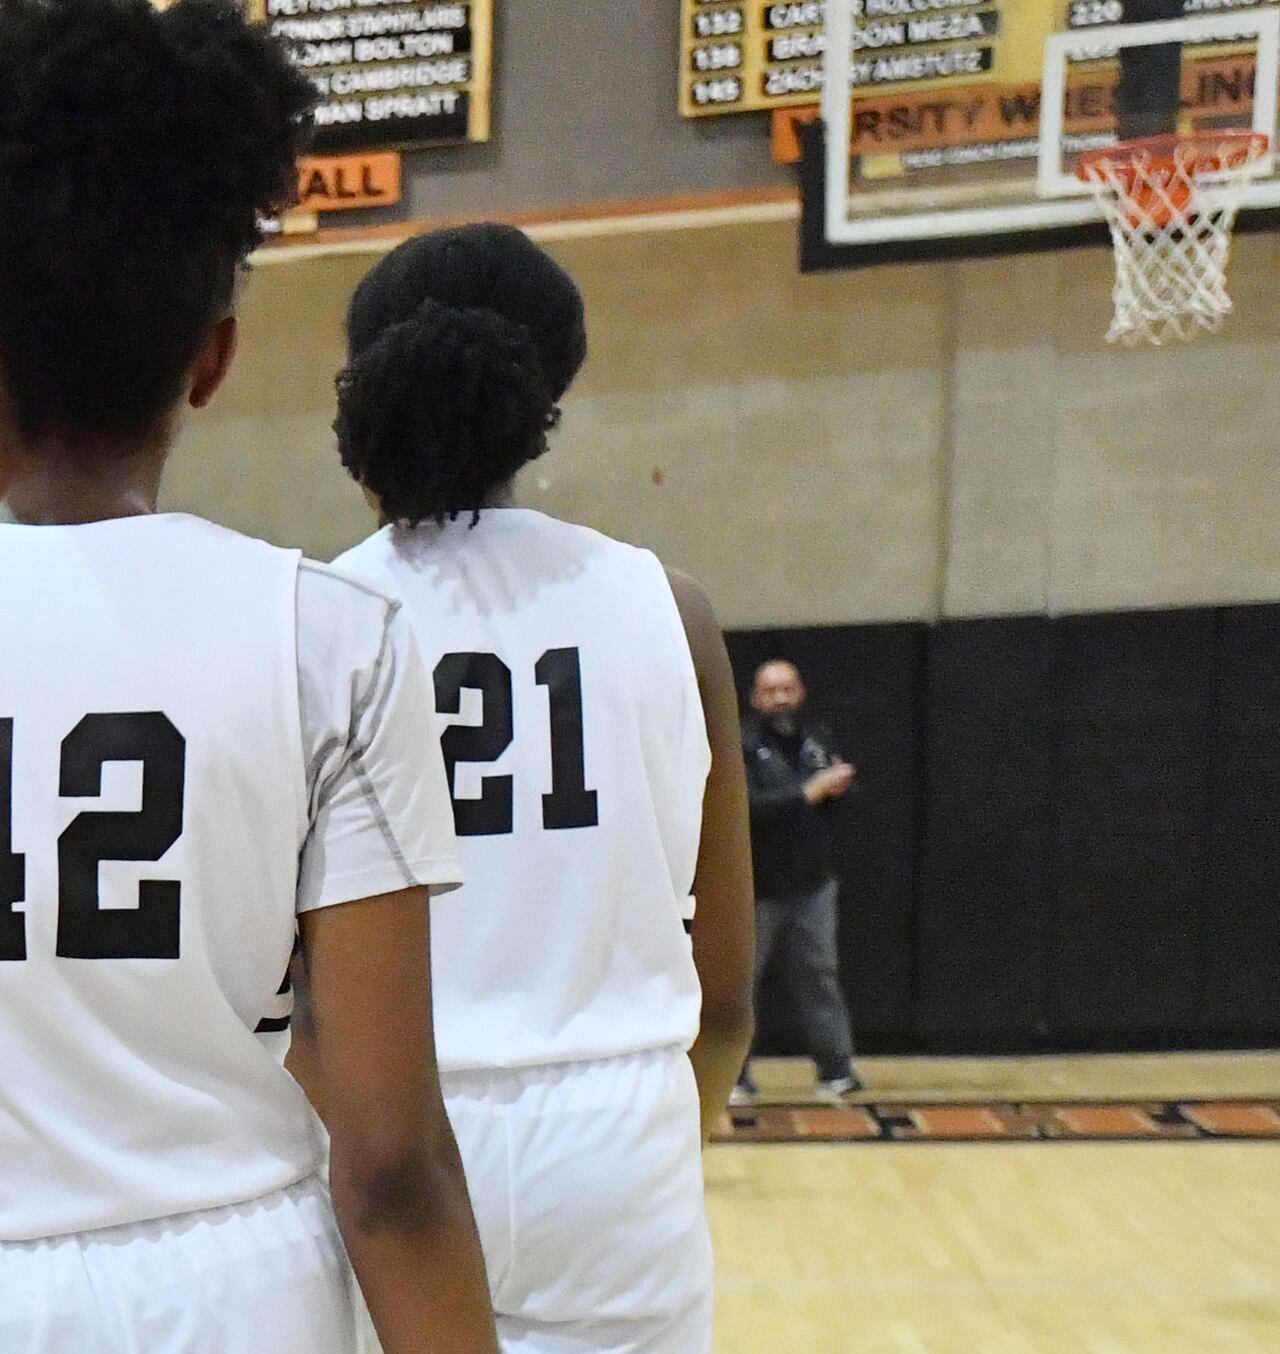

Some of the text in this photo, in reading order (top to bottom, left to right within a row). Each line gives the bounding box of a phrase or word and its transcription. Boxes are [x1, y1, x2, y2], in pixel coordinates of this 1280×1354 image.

[354, 32, 453, 61] BOLTON
[301, 163, 385, 198] ALL
[431, 646, 598, 836] 21
